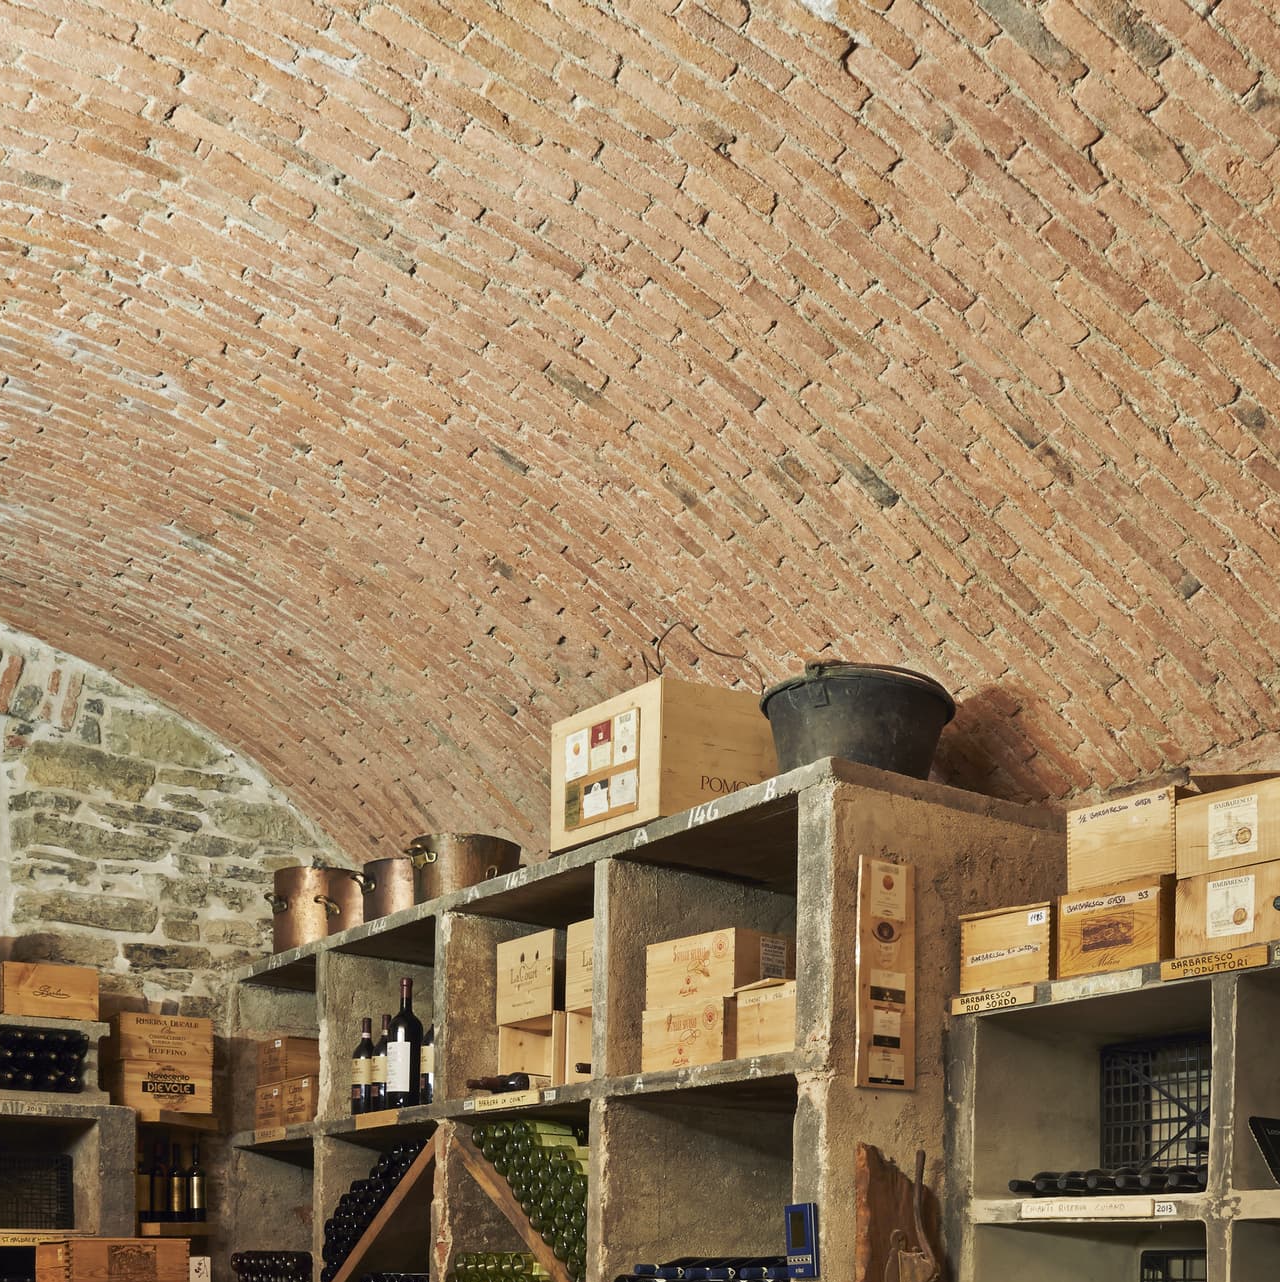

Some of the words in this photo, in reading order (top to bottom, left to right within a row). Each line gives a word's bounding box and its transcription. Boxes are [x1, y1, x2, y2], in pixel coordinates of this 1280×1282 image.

[1171, 952, 1233, 969] BARBARESCO
[960, 991, 1011, 1005] BARBARESCO
[966, 1003, 980, 1013] RIO
[986, 997, 1017, 1009] SORDO
[135, 1016, 167, 1027] RISERVA
[170, 1018, 199, 1029] DUCALE
[148, 1047, 188, 1057] RUFFINO
[147, 1071, 190, 1082] Novecento
[146, 1083, 191, 1094] DIEVOLE
